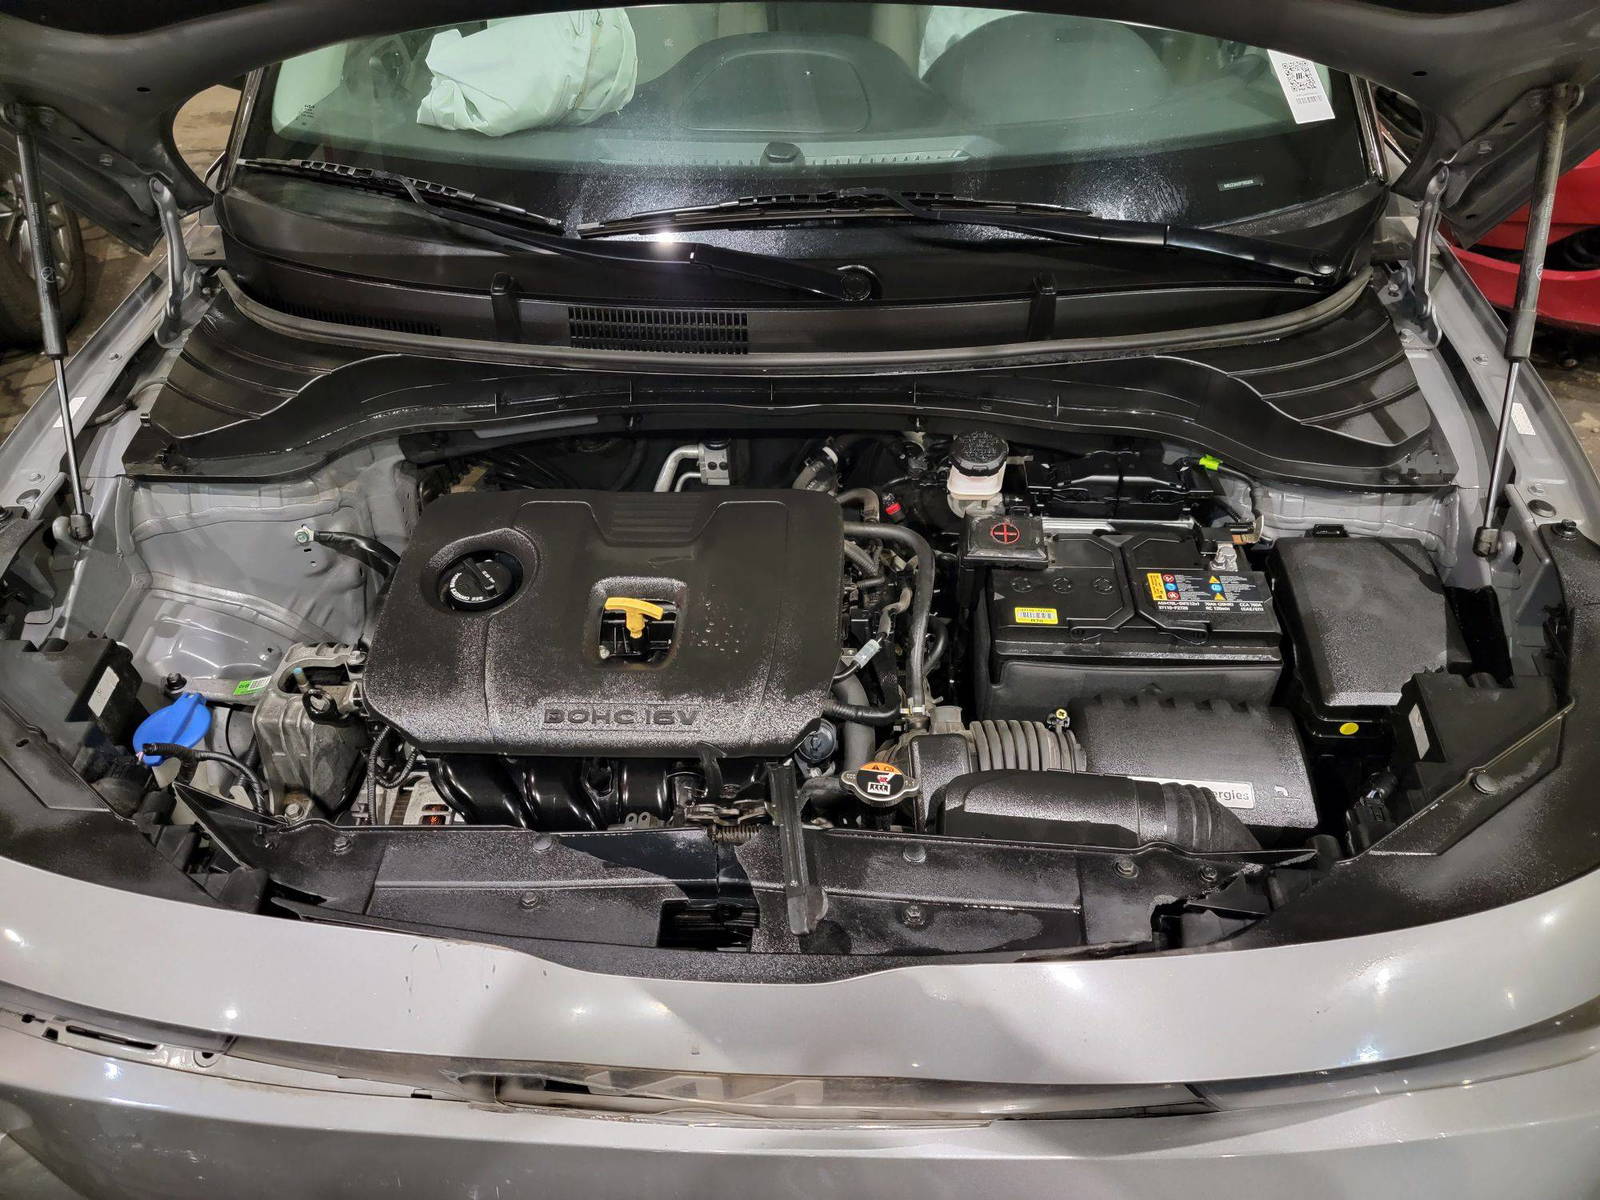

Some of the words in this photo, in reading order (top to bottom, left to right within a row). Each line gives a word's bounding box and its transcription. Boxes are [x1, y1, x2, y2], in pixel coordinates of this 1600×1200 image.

[543, 708, 635, 725] DOHC
[645, 709, 698, 726] 16V
[1213, 789, 1250, 801] ergies
